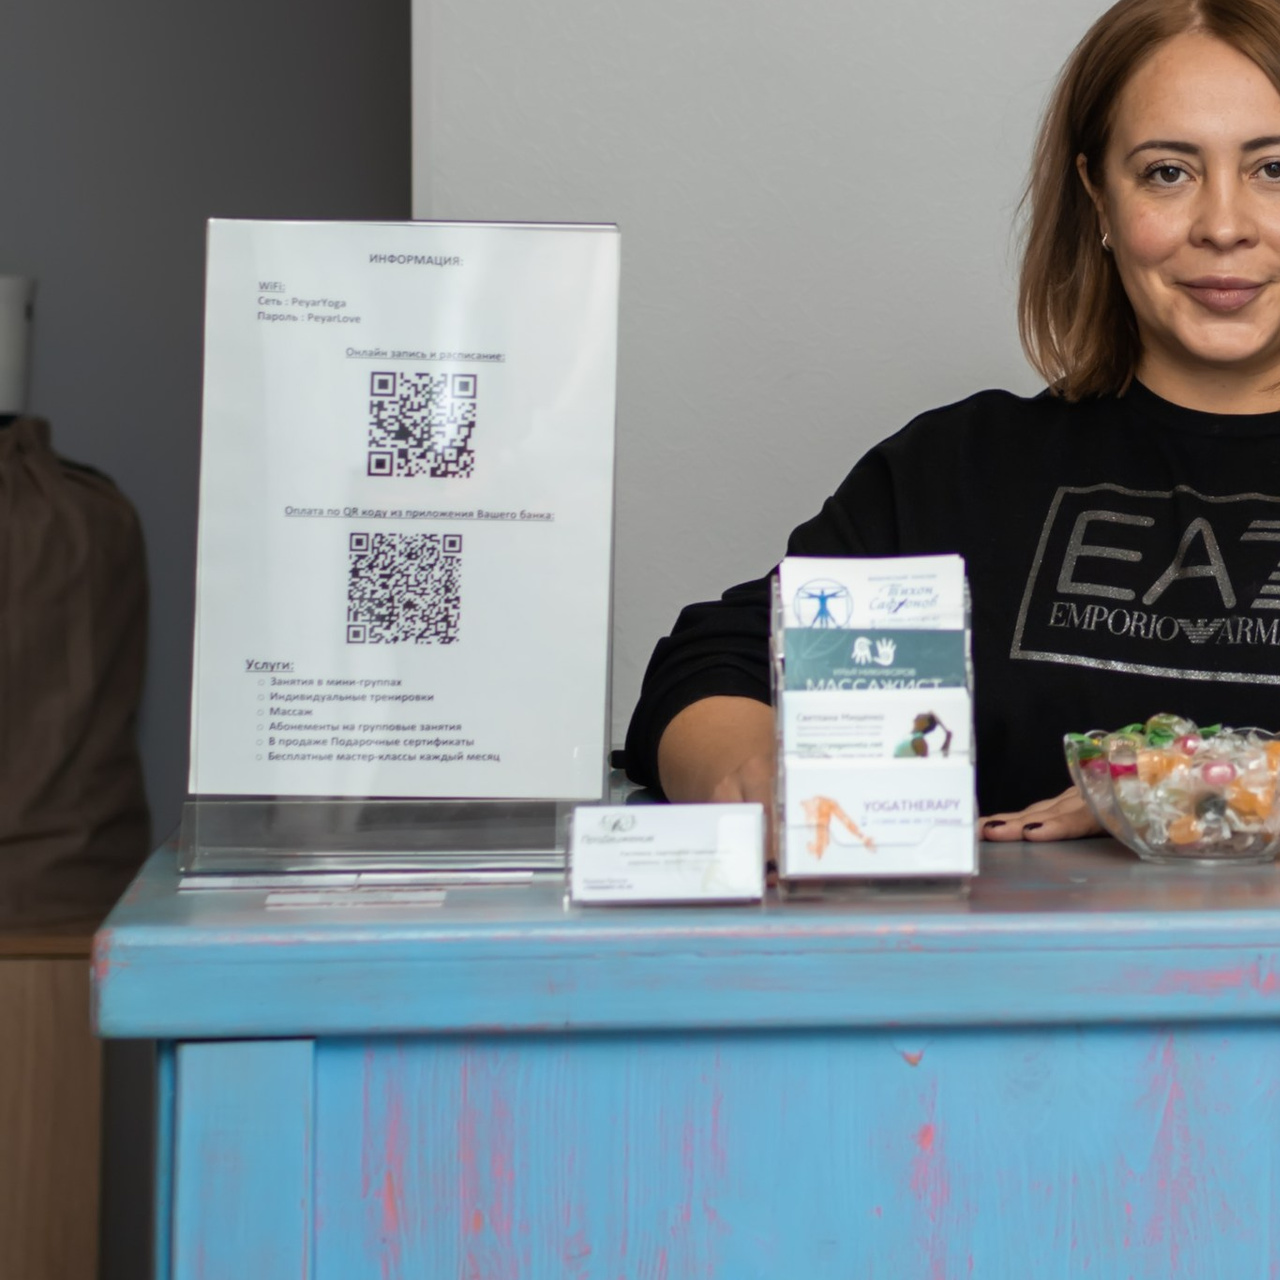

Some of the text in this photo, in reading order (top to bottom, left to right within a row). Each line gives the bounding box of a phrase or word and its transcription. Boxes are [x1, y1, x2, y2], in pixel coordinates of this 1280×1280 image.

[369, 253, 464, 267] ИНФОРМАЦИЯ:
[258, 281, 285, 293] WiFi:
[257, 296, 282, 306] Сеть
[291, 297, 347, 309] PeyarYoga
[257, 311, 298, 322] Пароль
[346, 347, 506, 363] Онлайн запись и расписание:
[284, 506, 555, 520] Оплата по QR коду из приложения Вашего банка:
[1047, 601, 1180, 642] EMPORIO
[245, 659, 295, 672] Услуги:
[270, 677, 314, 686] Занятия
[326, 679, 402, 688] мини-группах
[806, 677, 944, 691] МАССАЖИСТ
[270, 692, 434, 703] Индивидуальные тренировки
[269, 707, 313, 716] Массаж
[269, 721, 339, 731] Абонементы
[359, 724, 417, 733] групповые
[268, 737, 475, 747] В продаже Подарочные сертификаты
[268, 752, 501, 762] Бесплатные мастер-классы каждый месяц
